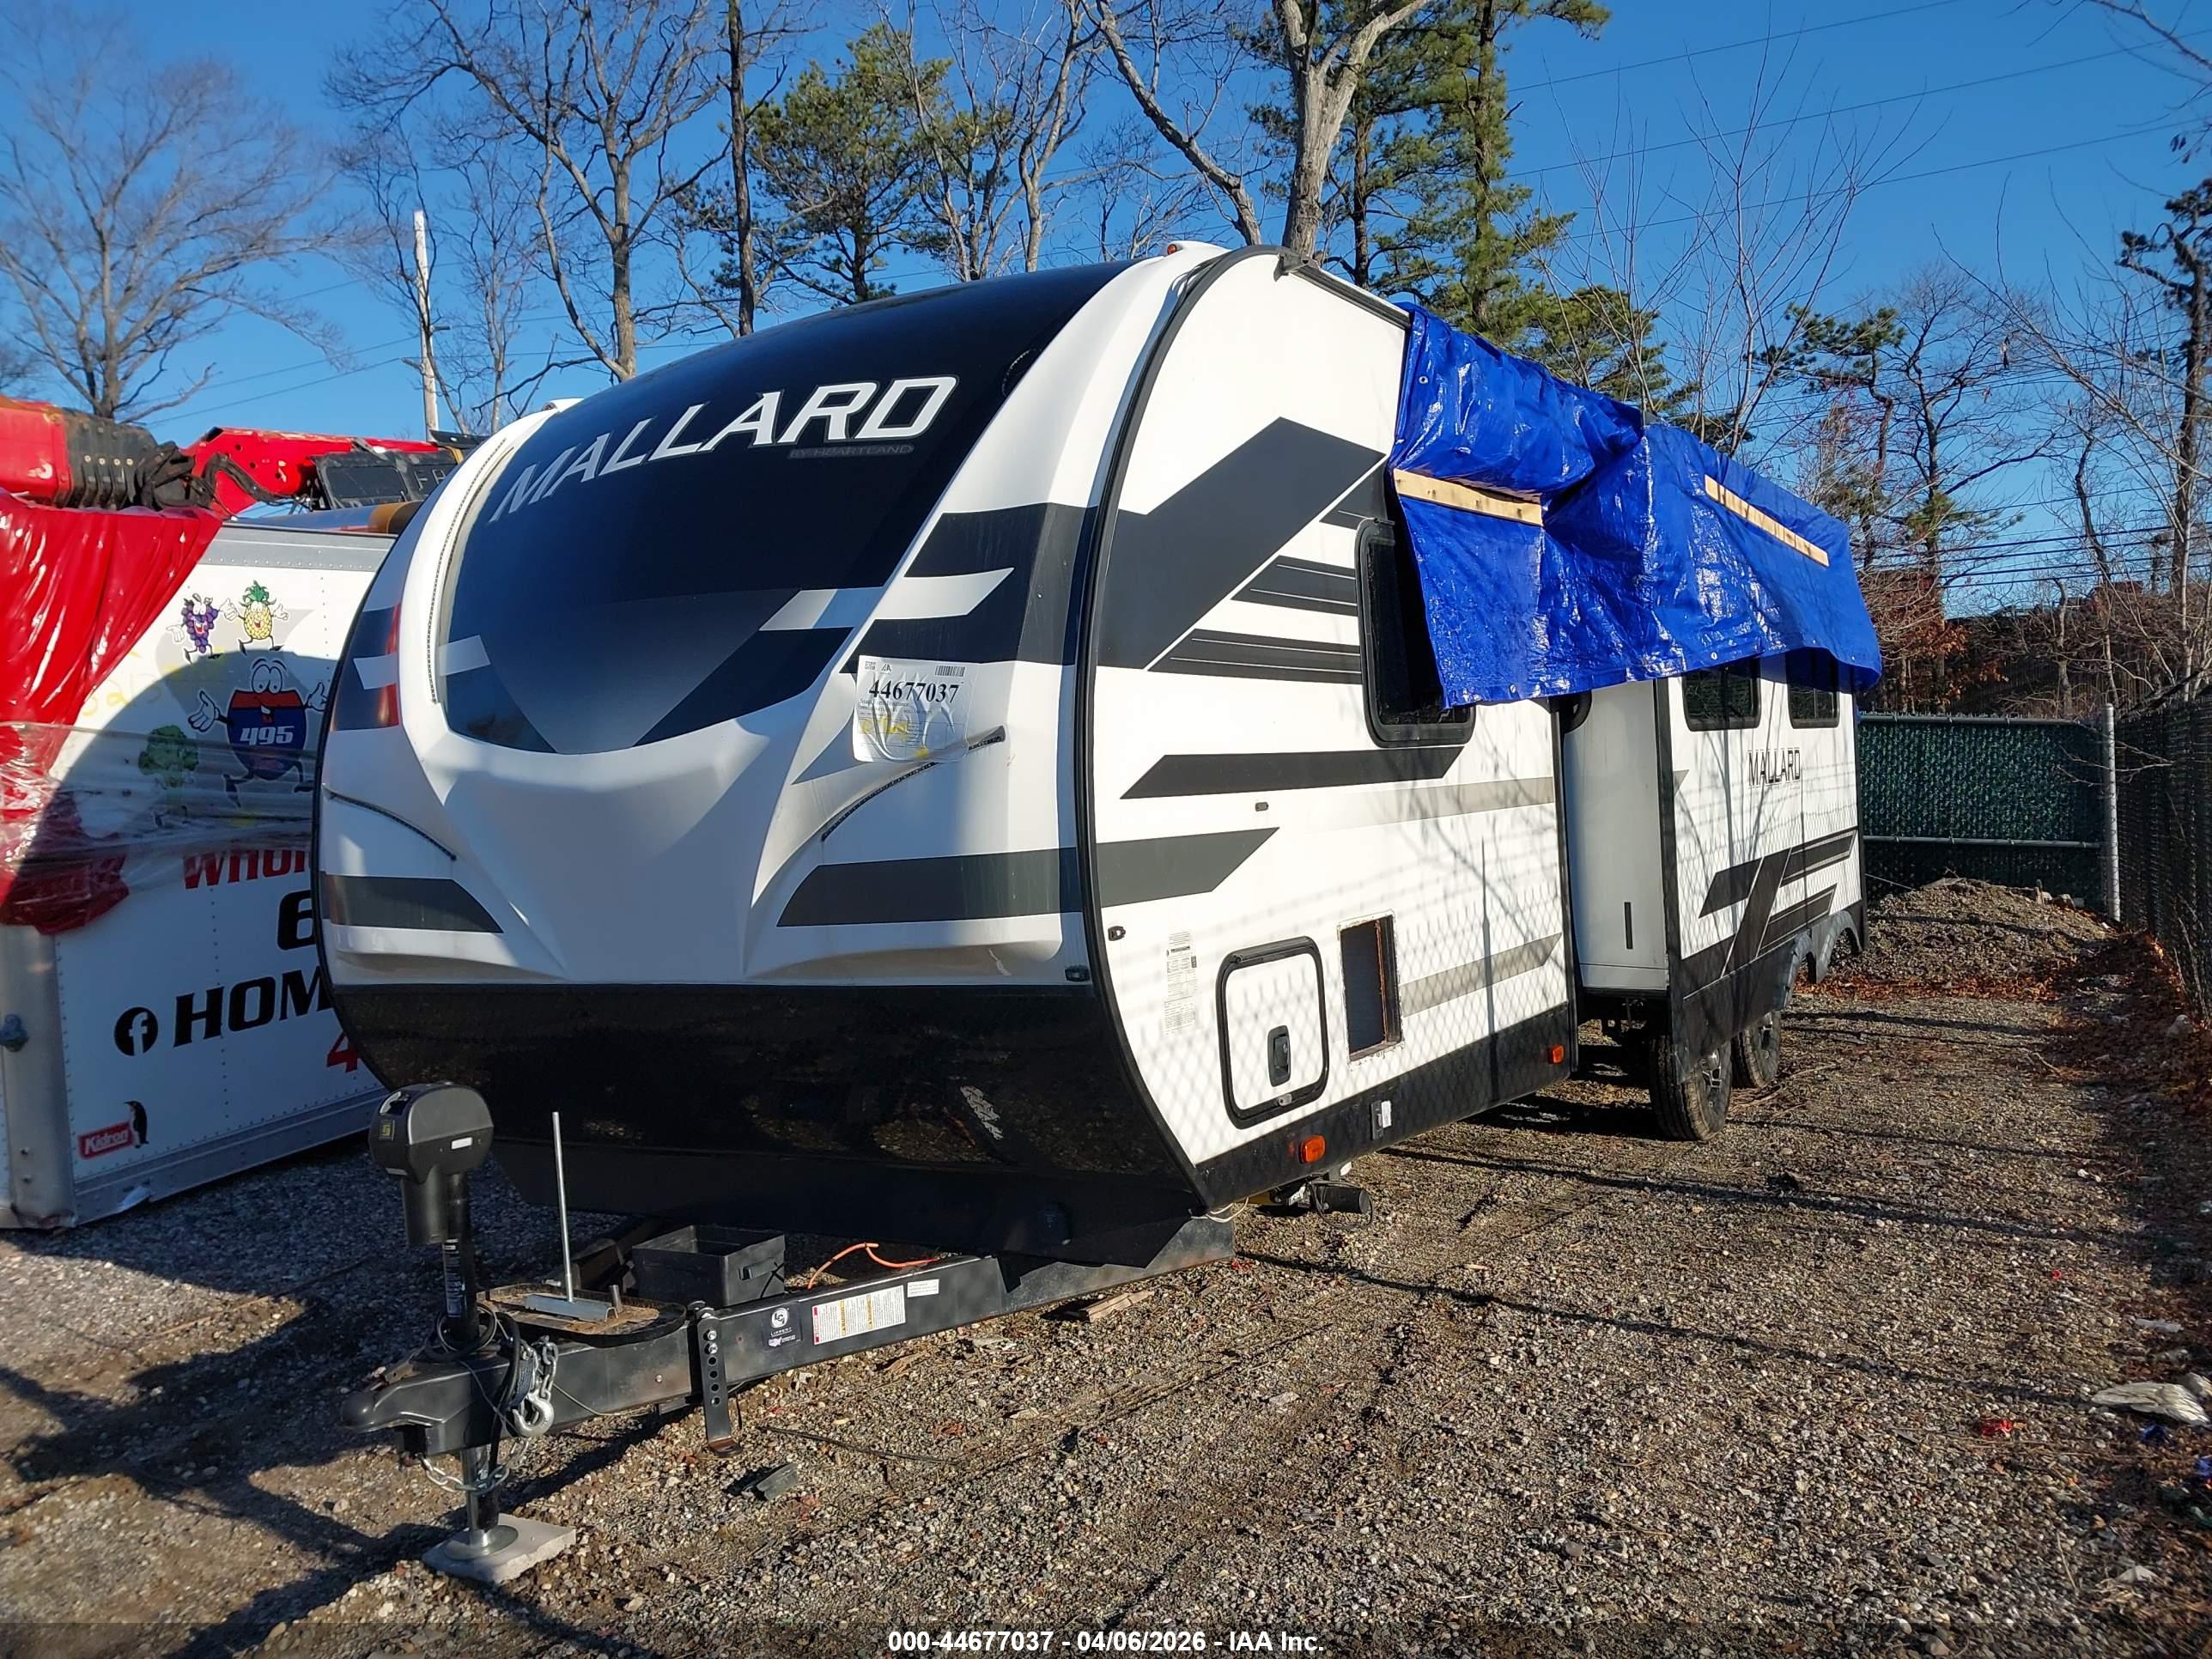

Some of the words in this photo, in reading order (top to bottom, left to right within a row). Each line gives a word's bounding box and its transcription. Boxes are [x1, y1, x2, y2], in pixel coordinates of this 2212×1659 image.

[488, 375, 959, 521] MALLARD
[815, 444, 915, 457] HEARTLAND
[869, 678, 959, 703] 44677037
[240, 726, 295, 744] 495
[1748, 749, 1801, 787] MALLARD
[85, 1129, 130, 1155] Kidron
